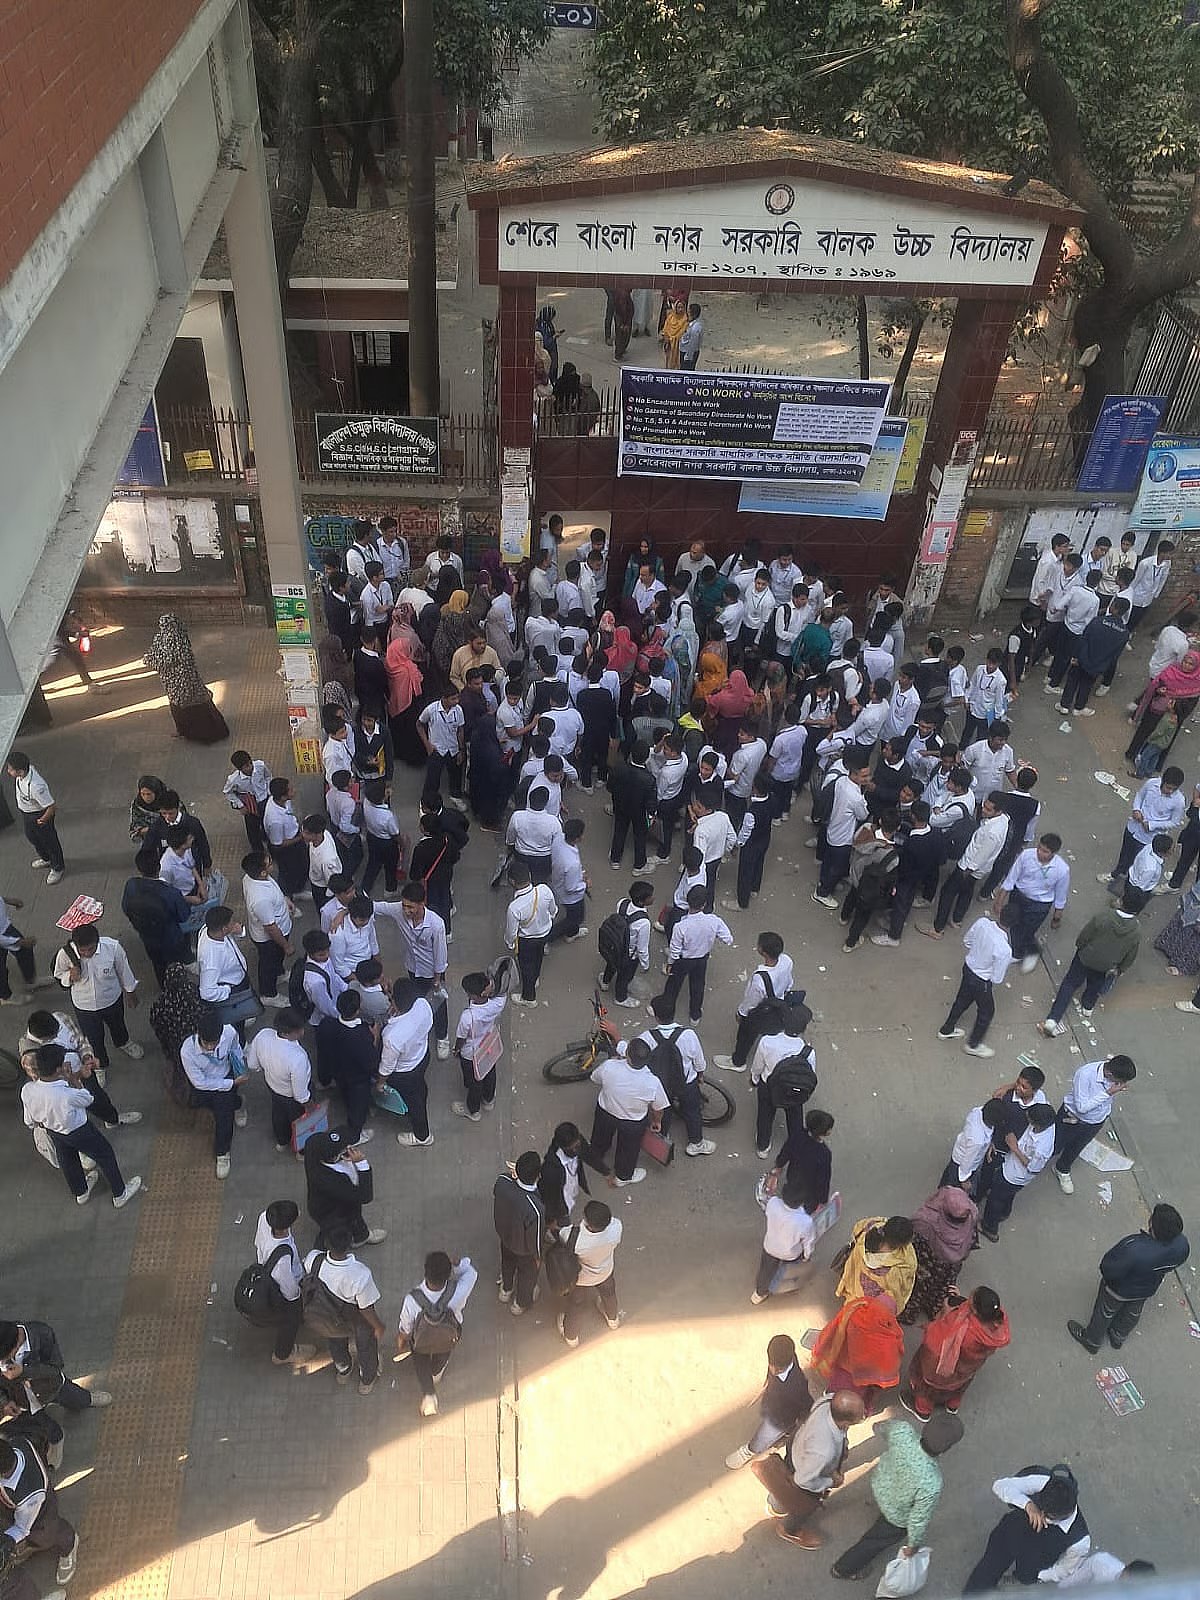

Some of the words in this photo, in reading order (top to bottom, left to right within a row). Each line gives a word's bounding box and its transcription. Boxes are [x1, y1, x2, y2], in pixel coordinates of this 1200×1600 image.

[505, 218, 560, 248] শেরে
[576, 219, 637, 252] বাংলা
[653, 224, 704, 254] নগর
[721, 221, 802, 256] সরকারি
[817, 228, 877, 257] বালক
[892, 224, 935, 257] উচ্চ
[949, 225, 1035, 263] বিদ্যালয়
[776, 263, 829, 277] স্থাপিত
[849, 266, 897, 278] ১৯৬৯
[695, 388, 710, 396] NO
[712, 389, 743, 398] WORK
[645, 407, 668, 415] Gazette
[669, 408, 676, 416] of
[677, 410, 710, 418] Secondary
[711, 411, 745, 419] Directorate
[678, 419, 707, 427] Advance
[709, 419, 742, 428] Increment
[754, 422, 771, 430] Work
[320, 425, 352, 450] বাংলাদেশ
[371, 417, 418, 442] বিশ্ববিদ্যালয়
[643, 426, 677, 434] Promotion
[689, 428, 706, 436] Work
[643, 446, 682, 456] বাংলাদেশ
[720, 450, 753, 459] মাধ্যমিক
[756, 449, 782, 461] শিক্ষক
[786, 450, 811, 461] সমিতি
[684, 462, 703, 470] নগর
[705, 461, 736, 471] সরকারি
[740, 464, 762, 472] বালক
[288, 588, 305, 596] BCS
